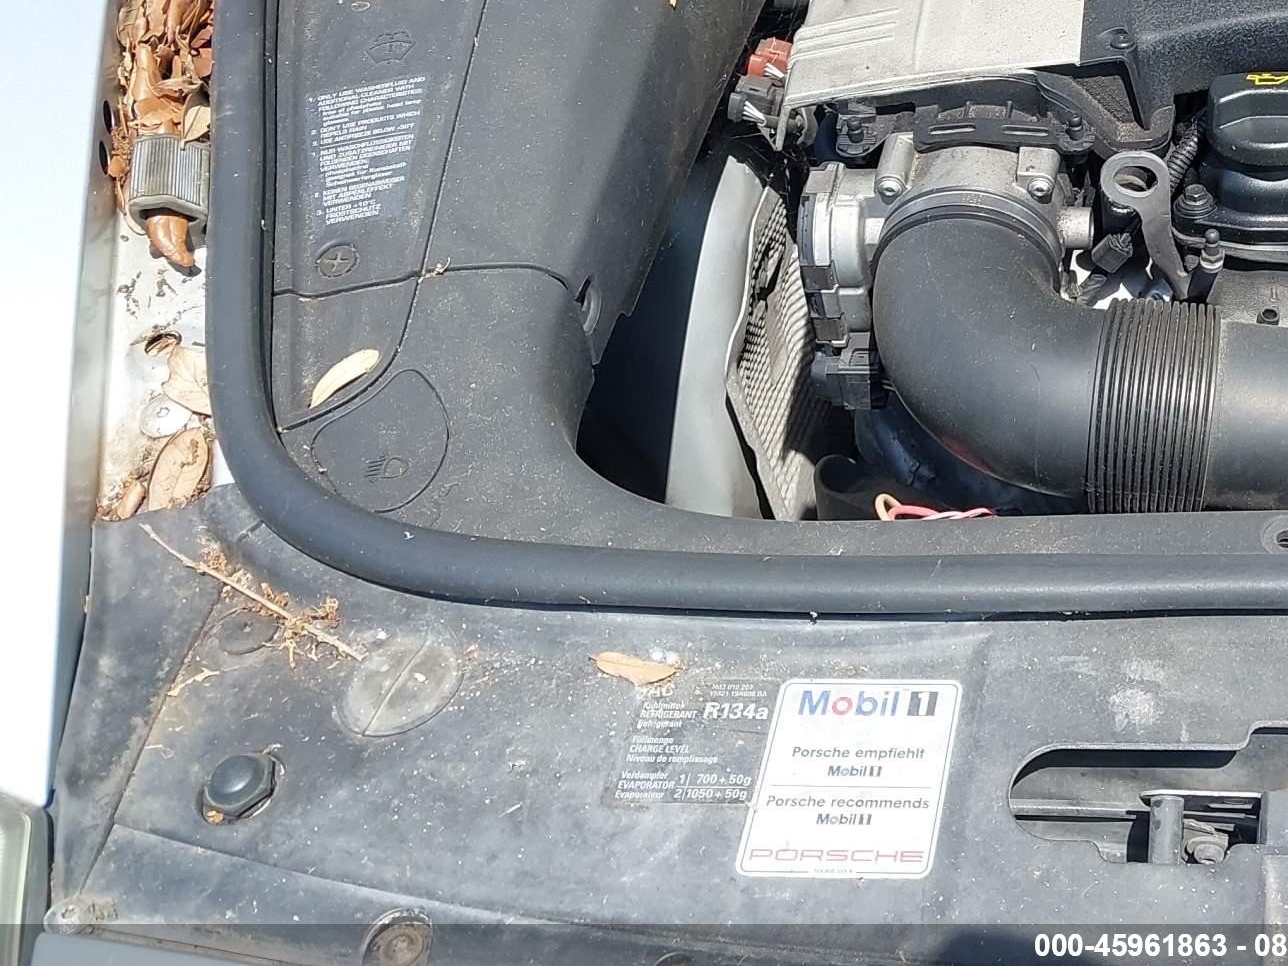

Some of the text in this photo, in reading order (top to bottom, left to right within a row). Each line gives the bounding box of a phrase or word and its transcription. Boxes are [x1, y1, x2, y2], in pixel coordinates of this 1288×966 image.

[798, 690, 901, 716] Mobil
[702, 701, 769, 720] R134a
[628, 745, 664, 754] CHARGE
[792, 746, 926, 760] Porsche empfiehlt
[626, 754, 719, 765] Niveau de remplissage
[827, 765, 867, 777] Mobil
[618, 780, 675, 790] EVAPORATOR
[697, 774, 718, 784] 700
[728, 774, 752, 786] 50g
[686, 788, 714, 799] 1050
[724, 788, 748, 801] 50g
[766, 795, 930, 810] Porsche recommends
[816, 813, 856, 825] Mobil
[748, 848, 926, 864] PORSCHE
